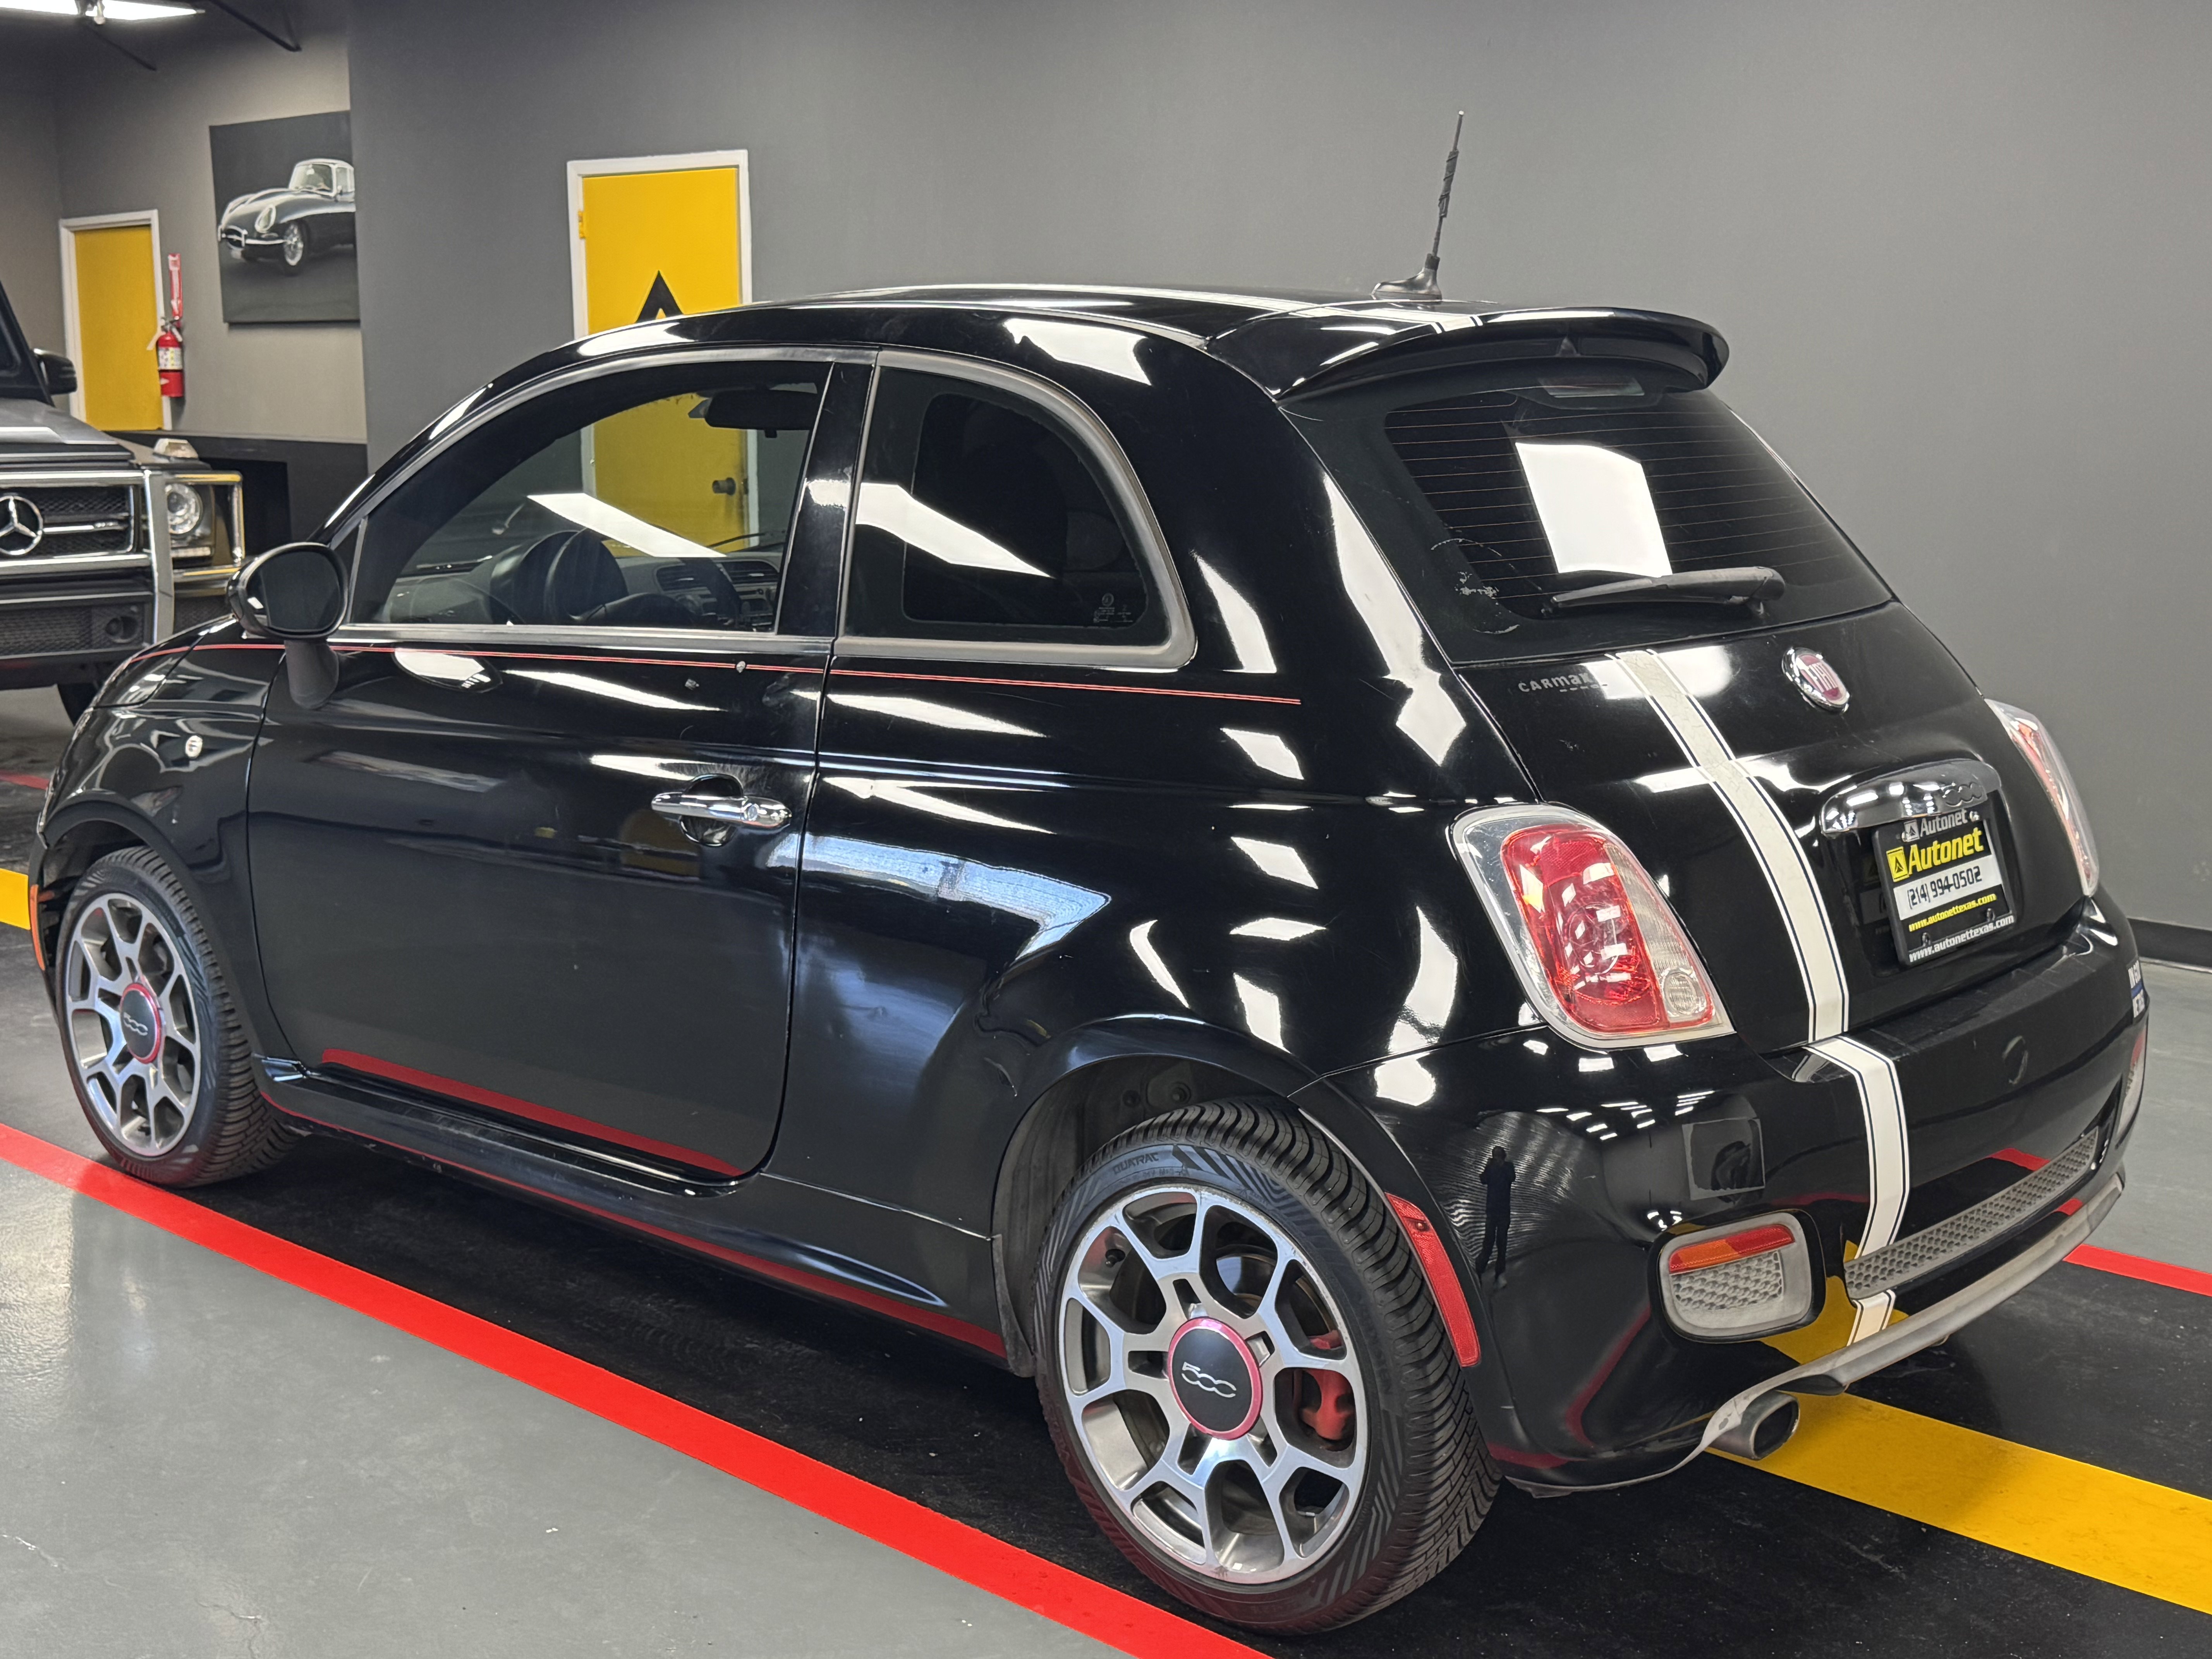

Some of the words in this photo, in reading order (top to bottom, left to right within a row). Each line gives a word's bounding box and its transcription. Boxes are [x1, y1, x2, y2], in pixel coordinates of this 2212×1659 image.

[1796, 657, 1838, 693] FIAT
[1920, 808, 1968, 838] Autonet
[1908, 827, 1984, 876] Autonet
[1907, 883, 1930, 910] (214)
[1930, 866, 1982, 898] 994-0502
[1908, 893, 1997, 932] www.autonettexas.com
[1909, 915, 2014, 963] www.autonettexas.com
[123, 1012, 148, 1036] 500
[1181, 1361, 1237, 1398] 500
